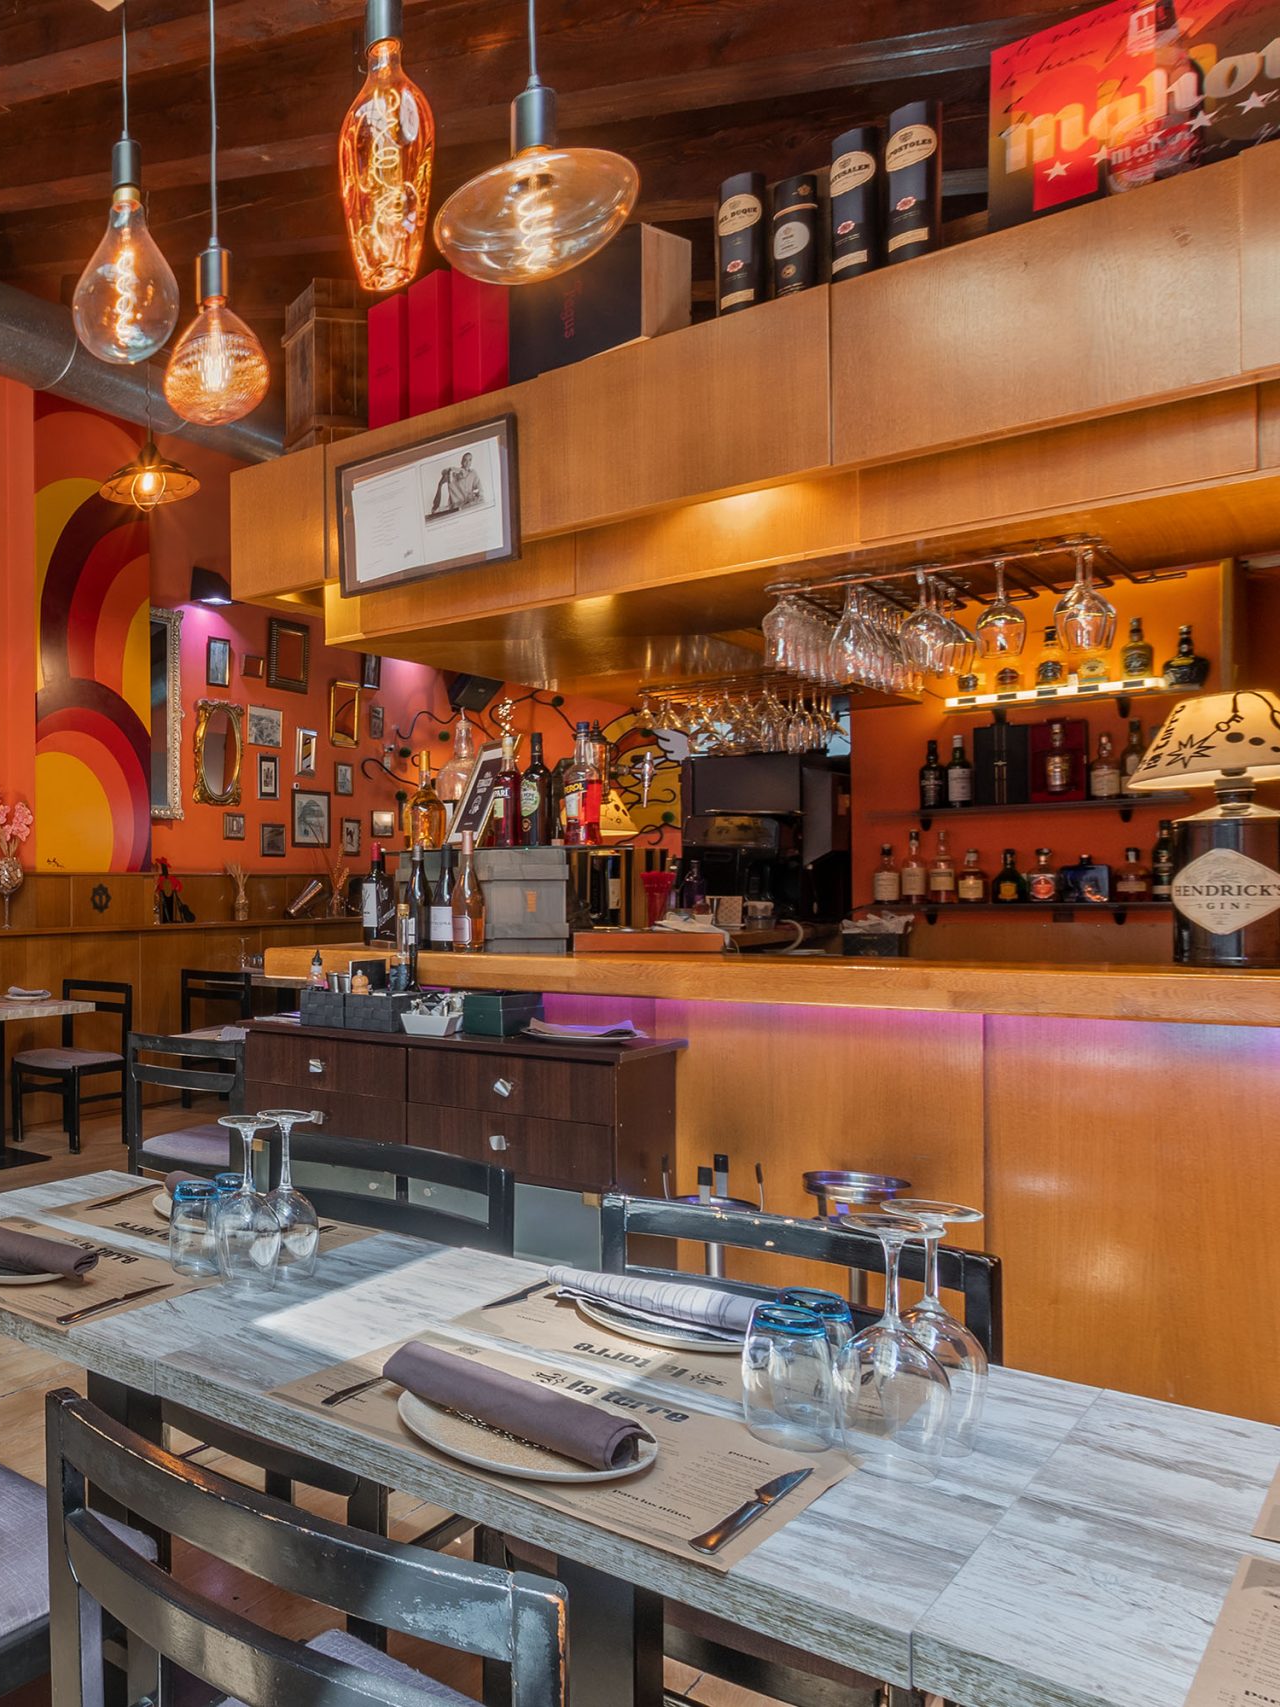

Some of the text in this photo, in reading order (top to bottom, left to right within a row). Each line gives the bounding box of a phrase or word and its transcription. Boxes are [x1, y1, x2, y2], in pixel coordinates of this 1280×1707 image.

[493, 788, 510, 799] PARI
[564, 782, 585, 794] EROL
[1206, 902, 1240, 910] GIN
[572, 1342, 652, 1369] torre
[658, 1363, 690, 1379] la
[565, 1379, 690, 1423] la torre
